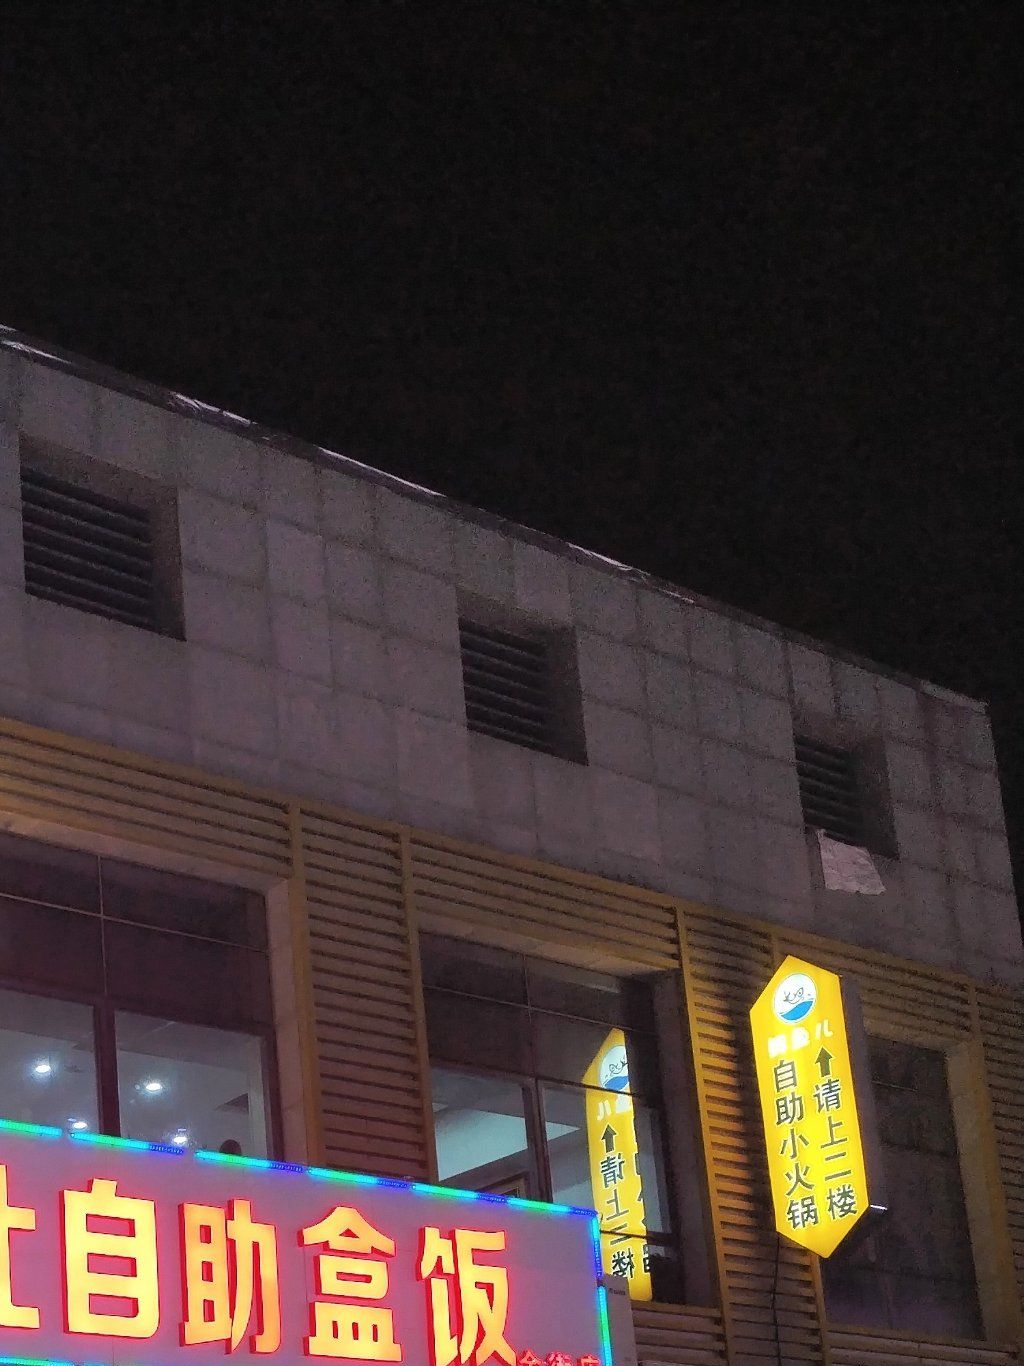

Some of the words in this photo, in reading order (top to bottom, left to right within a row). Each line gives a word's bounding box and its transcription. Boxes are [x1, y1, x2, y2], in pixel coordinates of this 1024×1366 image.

[773, 1059, 819, 1230] 自助小火锅
[812, 1078, 858, 1220] 请上二楼
